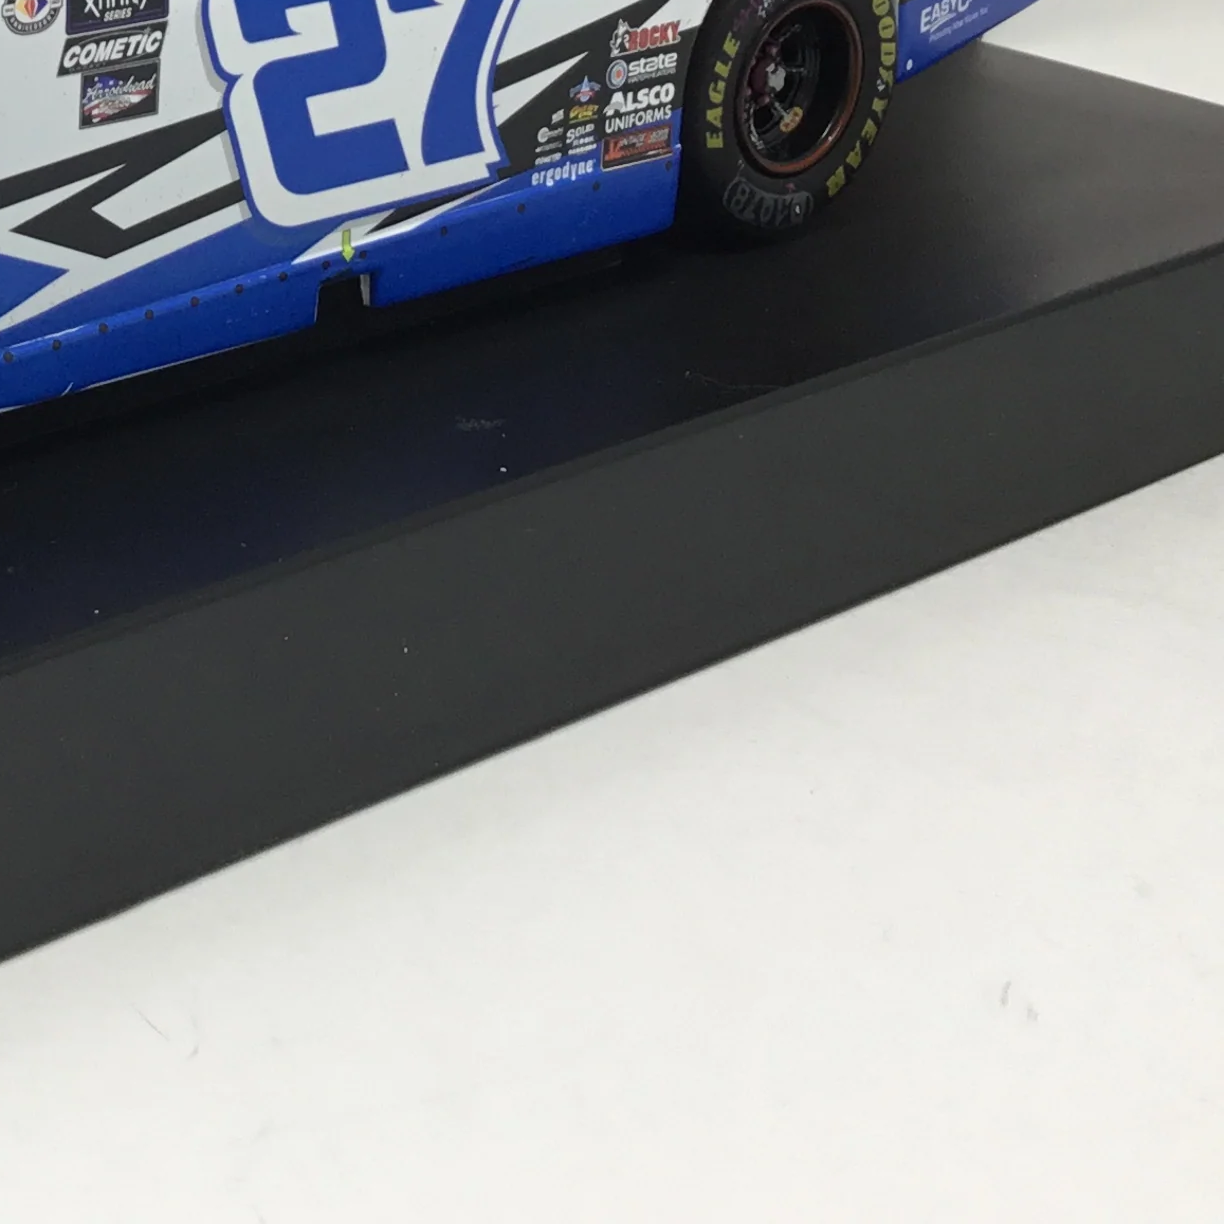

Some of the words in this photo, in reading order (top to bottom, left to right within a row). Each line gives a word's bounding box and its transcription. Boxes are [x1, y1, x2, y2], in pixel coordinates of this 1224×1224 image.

[103, 6, 133, 22] SERIES
[62, 29, 164, 69] COMETIC
[628, 19, 682, 53] ROCKY
[627, 52, 678, 77] state
[82, 73, 157, 104] Arrowhead
[603, 82, 676, 117] ALSCO
[705, 32, 743, 150] EAGLE
[605, 104, 673, 134] UNIFORMS
[531, 159, 594, 187] ergodyne
